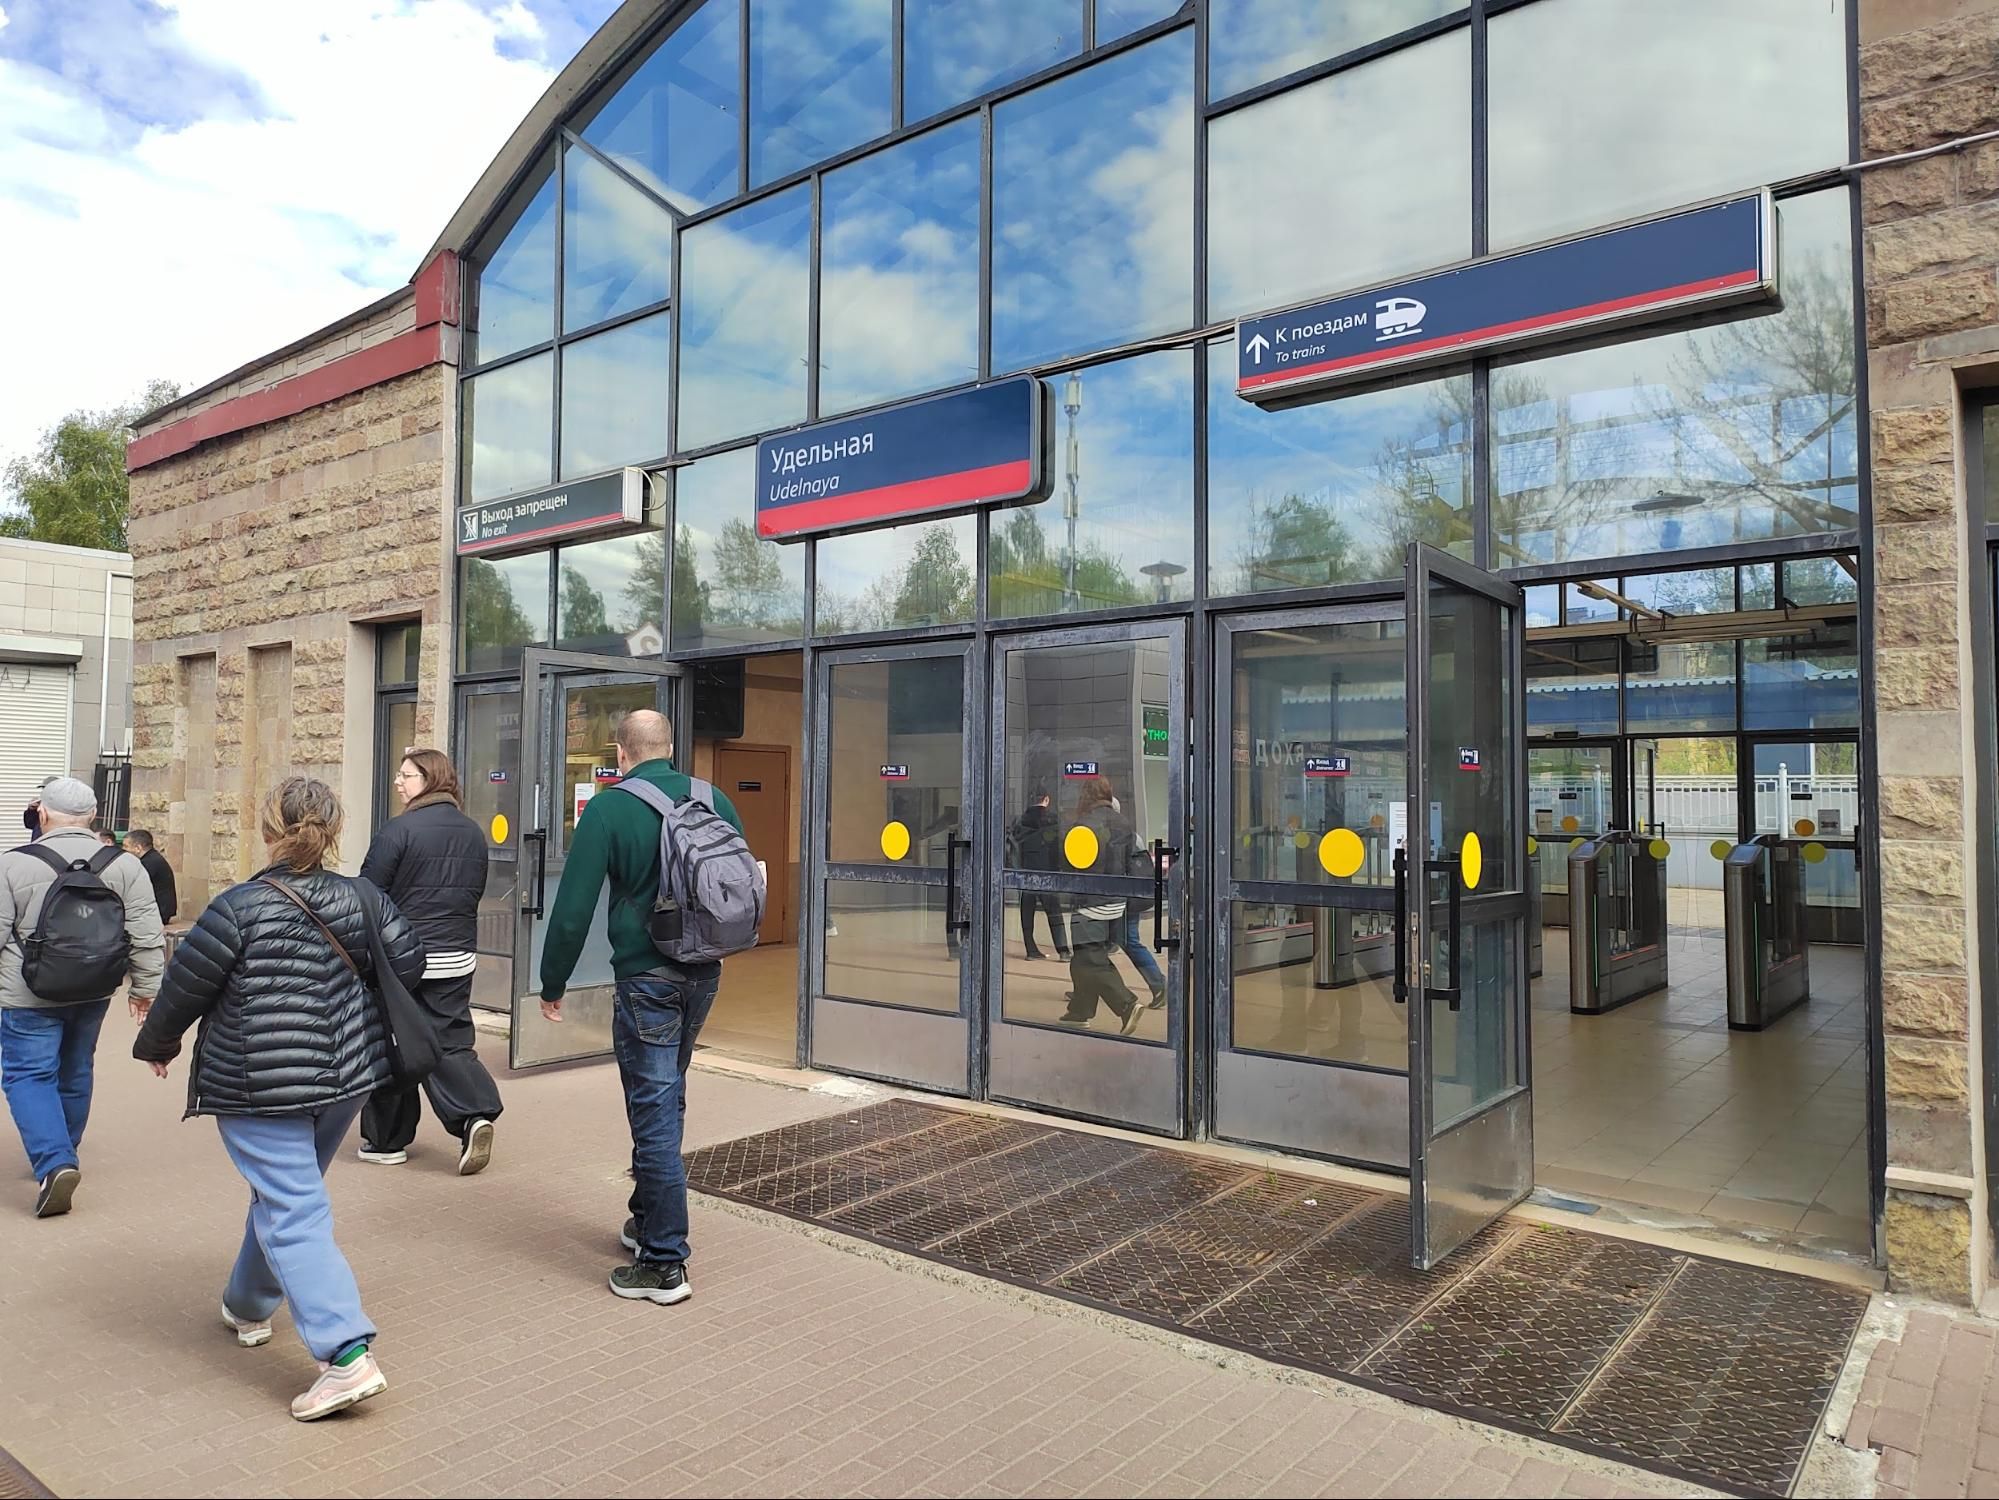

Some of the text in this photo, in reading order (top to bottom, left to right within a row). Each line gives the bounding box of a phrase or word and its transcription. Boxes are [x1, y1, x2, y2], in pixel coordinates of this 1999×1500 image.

[1275, 312, 1368, 344] К поездам
[1275, 344, 1326, 364] To trains
[771, 432, 874, 475] Удельная
[770, 475, 840, 502] Udelnaya
[481, 493, 568, 525] Выход запрещен
[481, 523, 508, 539] No exit
